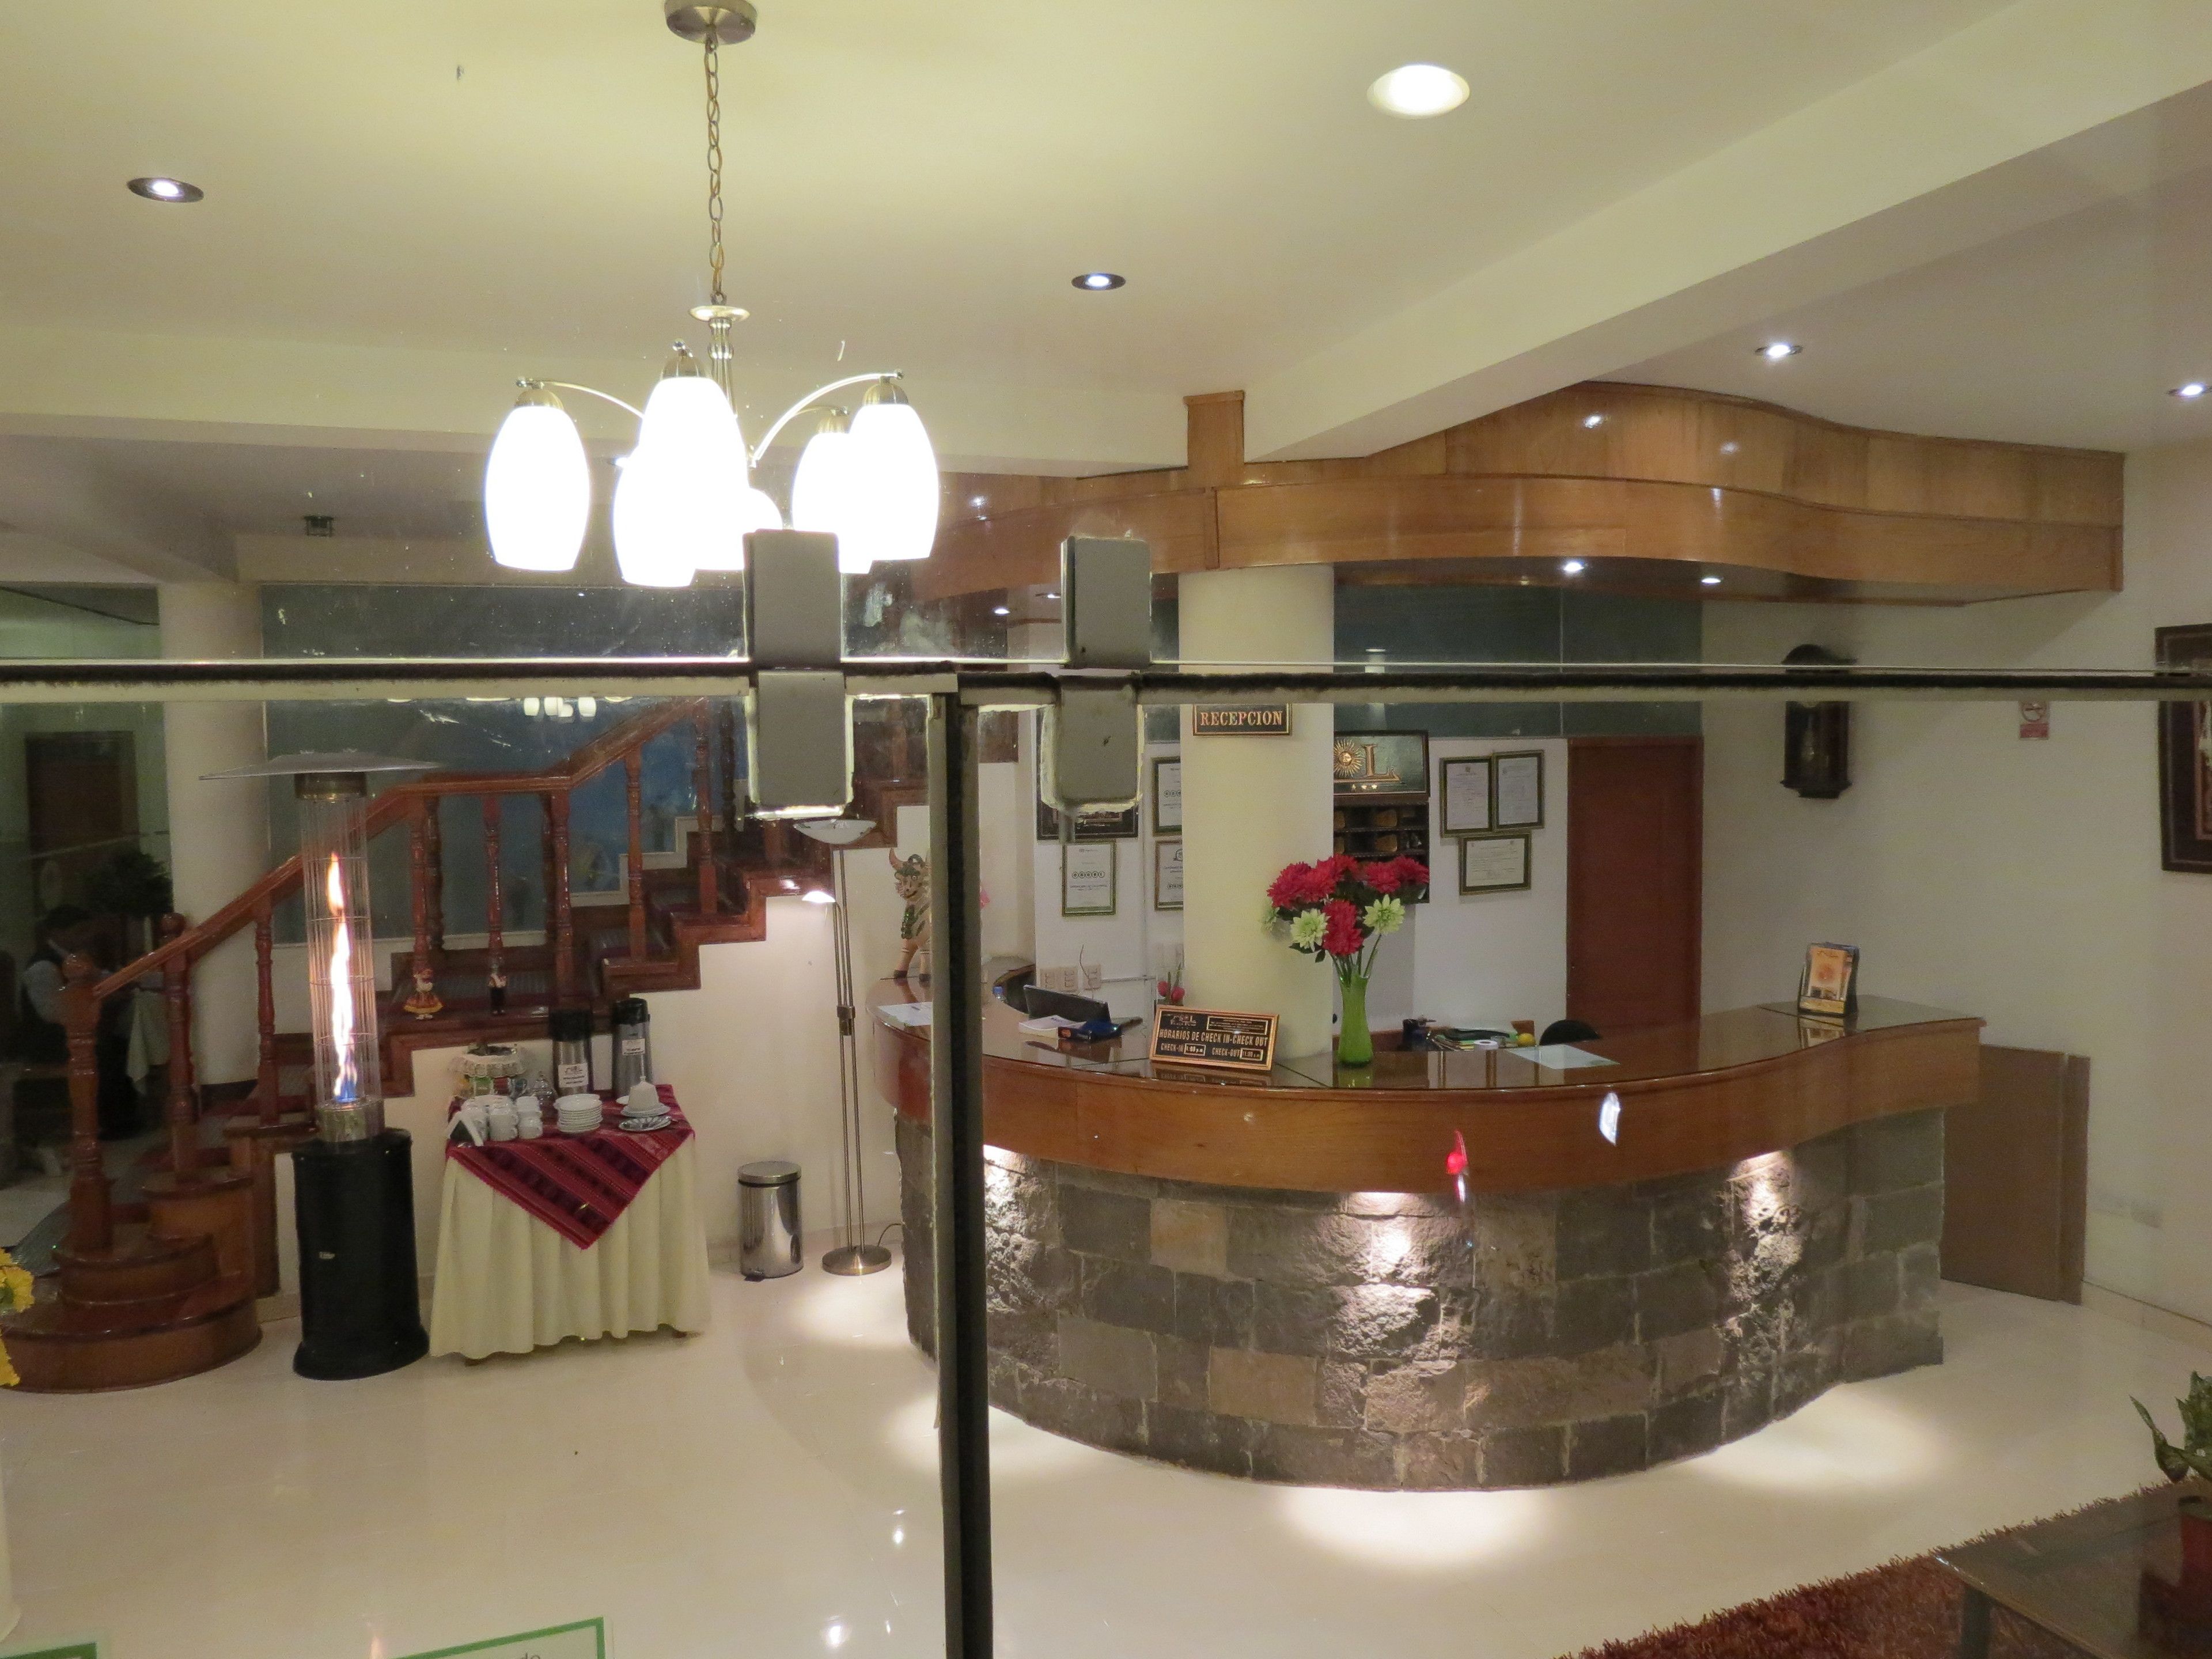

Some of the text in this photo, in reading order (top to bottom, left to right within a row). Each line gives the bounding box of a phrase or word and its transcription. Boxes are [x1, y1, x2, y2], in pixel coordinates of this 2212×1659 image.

[1200, 710, 1283, 726] RECEPCION
[1159, 1029, 1191, 1040] HORARIOS
[1191, 1031, 1200, 1041] DE
[1201, 1032, 1222, 1043] CHECK
[1255, 1037, 1268, 1047] OUT
[1161, 1043, 1184, 1052] CHECK-IN
[1211, 1047, 1240, 1057] CHECK-OUT
